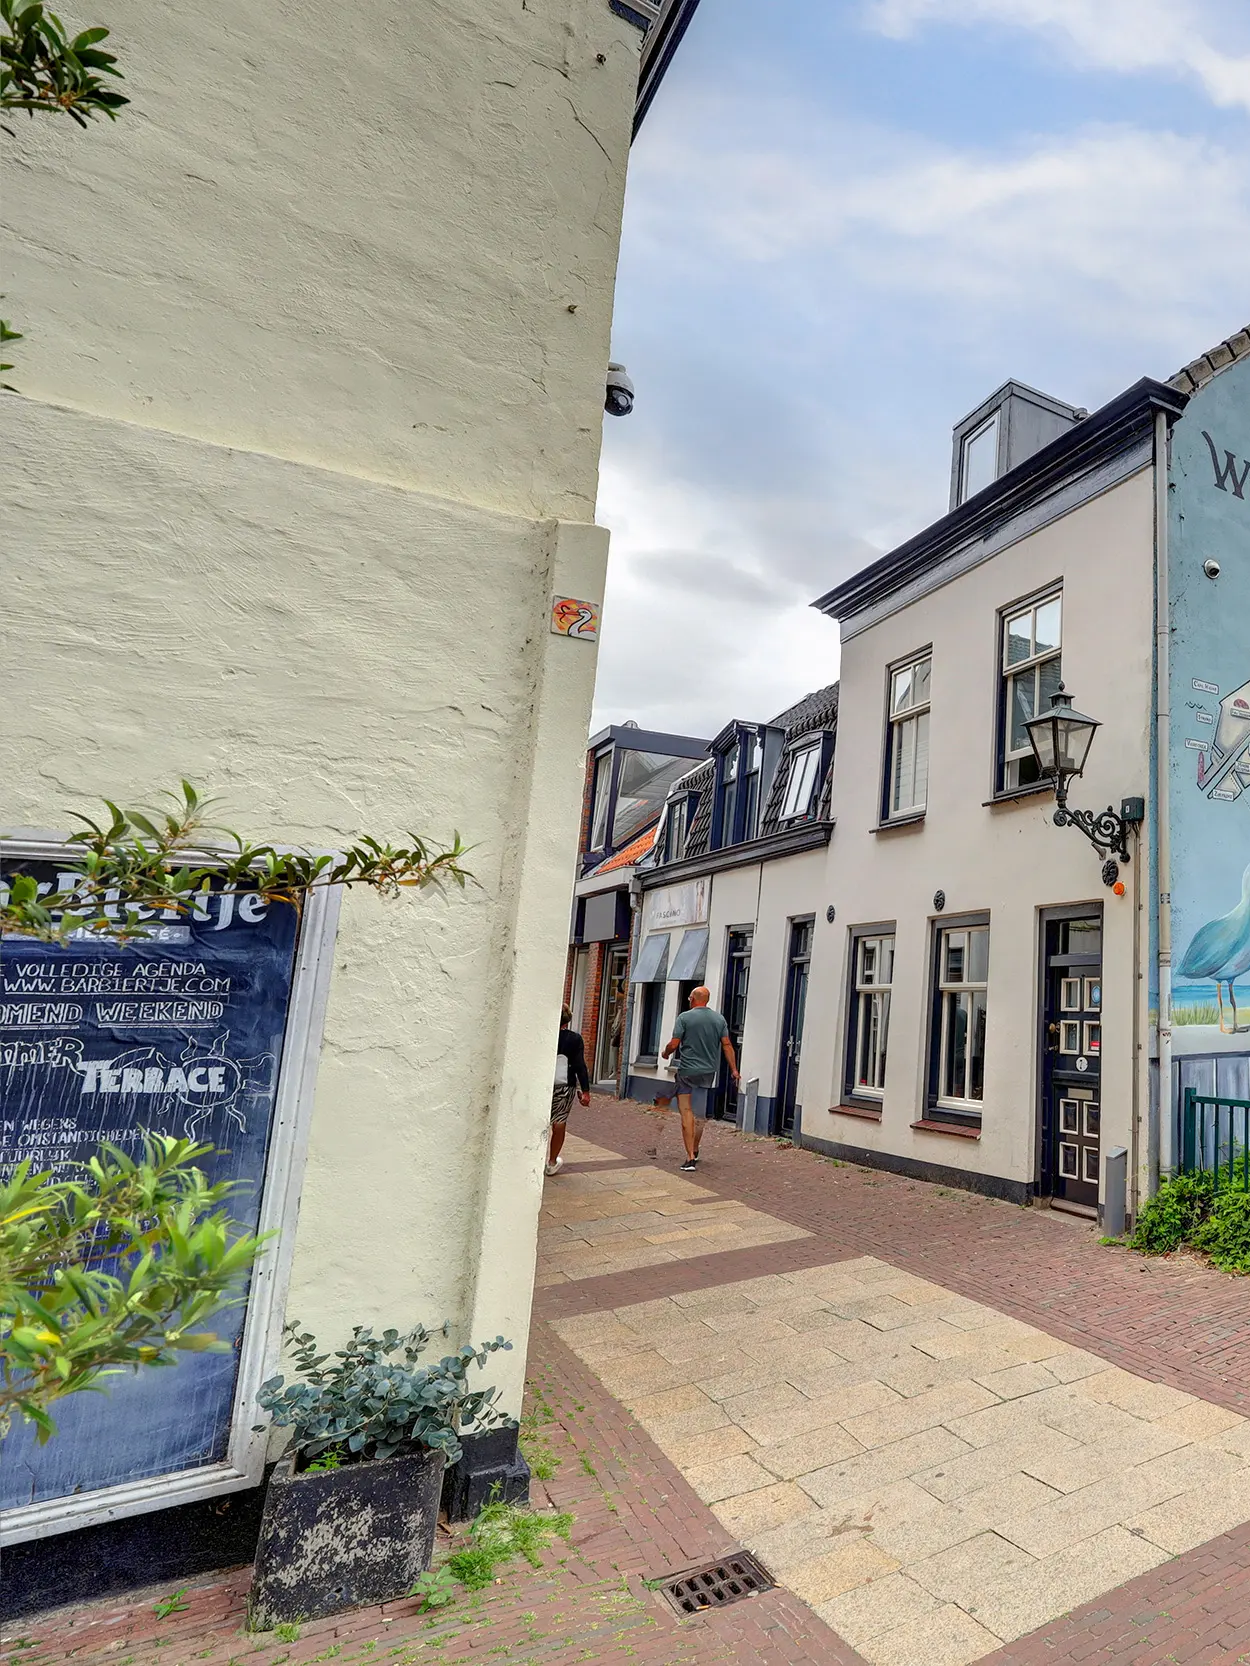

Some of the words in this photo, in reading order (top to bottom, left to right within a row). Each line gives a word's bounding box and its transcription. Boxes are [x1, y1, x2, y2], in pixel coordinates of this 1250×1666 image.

[16, 963, 124, 977] VOLLEDIGE
[132, 962, 207, 977] AGENDA
[95, 1000, 224, 1023] WEEKEND
[79, 1059, 227, 1094] TERRACE
